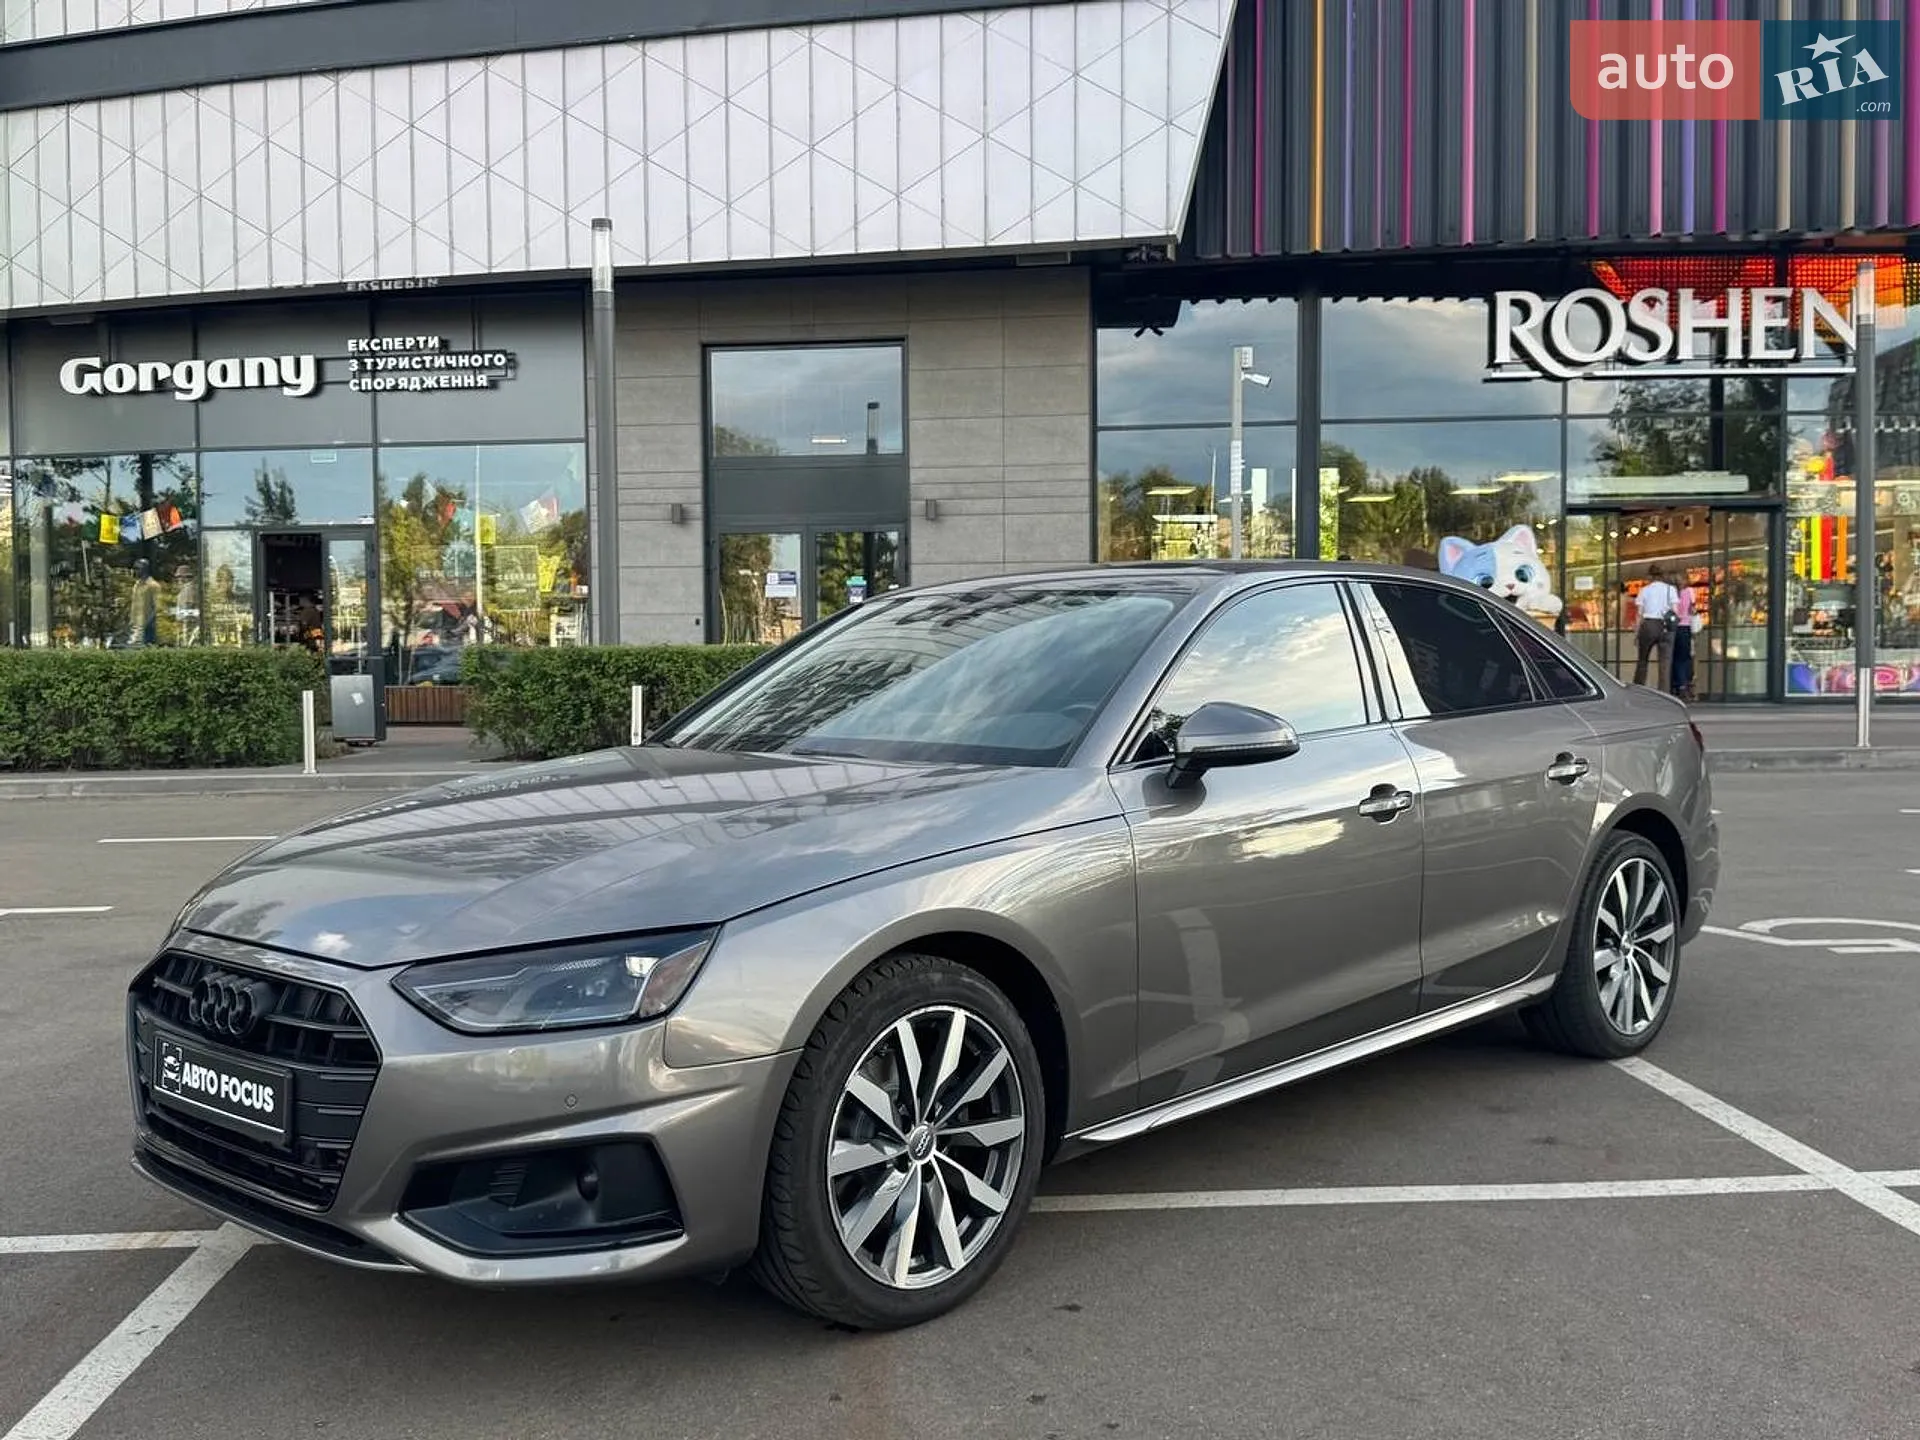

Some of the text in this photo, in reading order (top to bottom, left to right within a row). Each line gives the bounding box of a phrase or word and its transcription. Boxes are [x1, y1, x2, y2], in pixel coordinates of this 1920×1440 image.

[347, 335, 439, 351] ЕКСПЕРТИ
[1492, 287, 1856, 379] ROSHEN
[60, 354, 316, 401] Gorgany
[364, 353, 506, 371] ТУРИСТИЧНОГО
[349, 374, 488, 391] СПОРЯДЖЕННЯ
[182, 1062, 274, 1112] АВТО FOCUS
